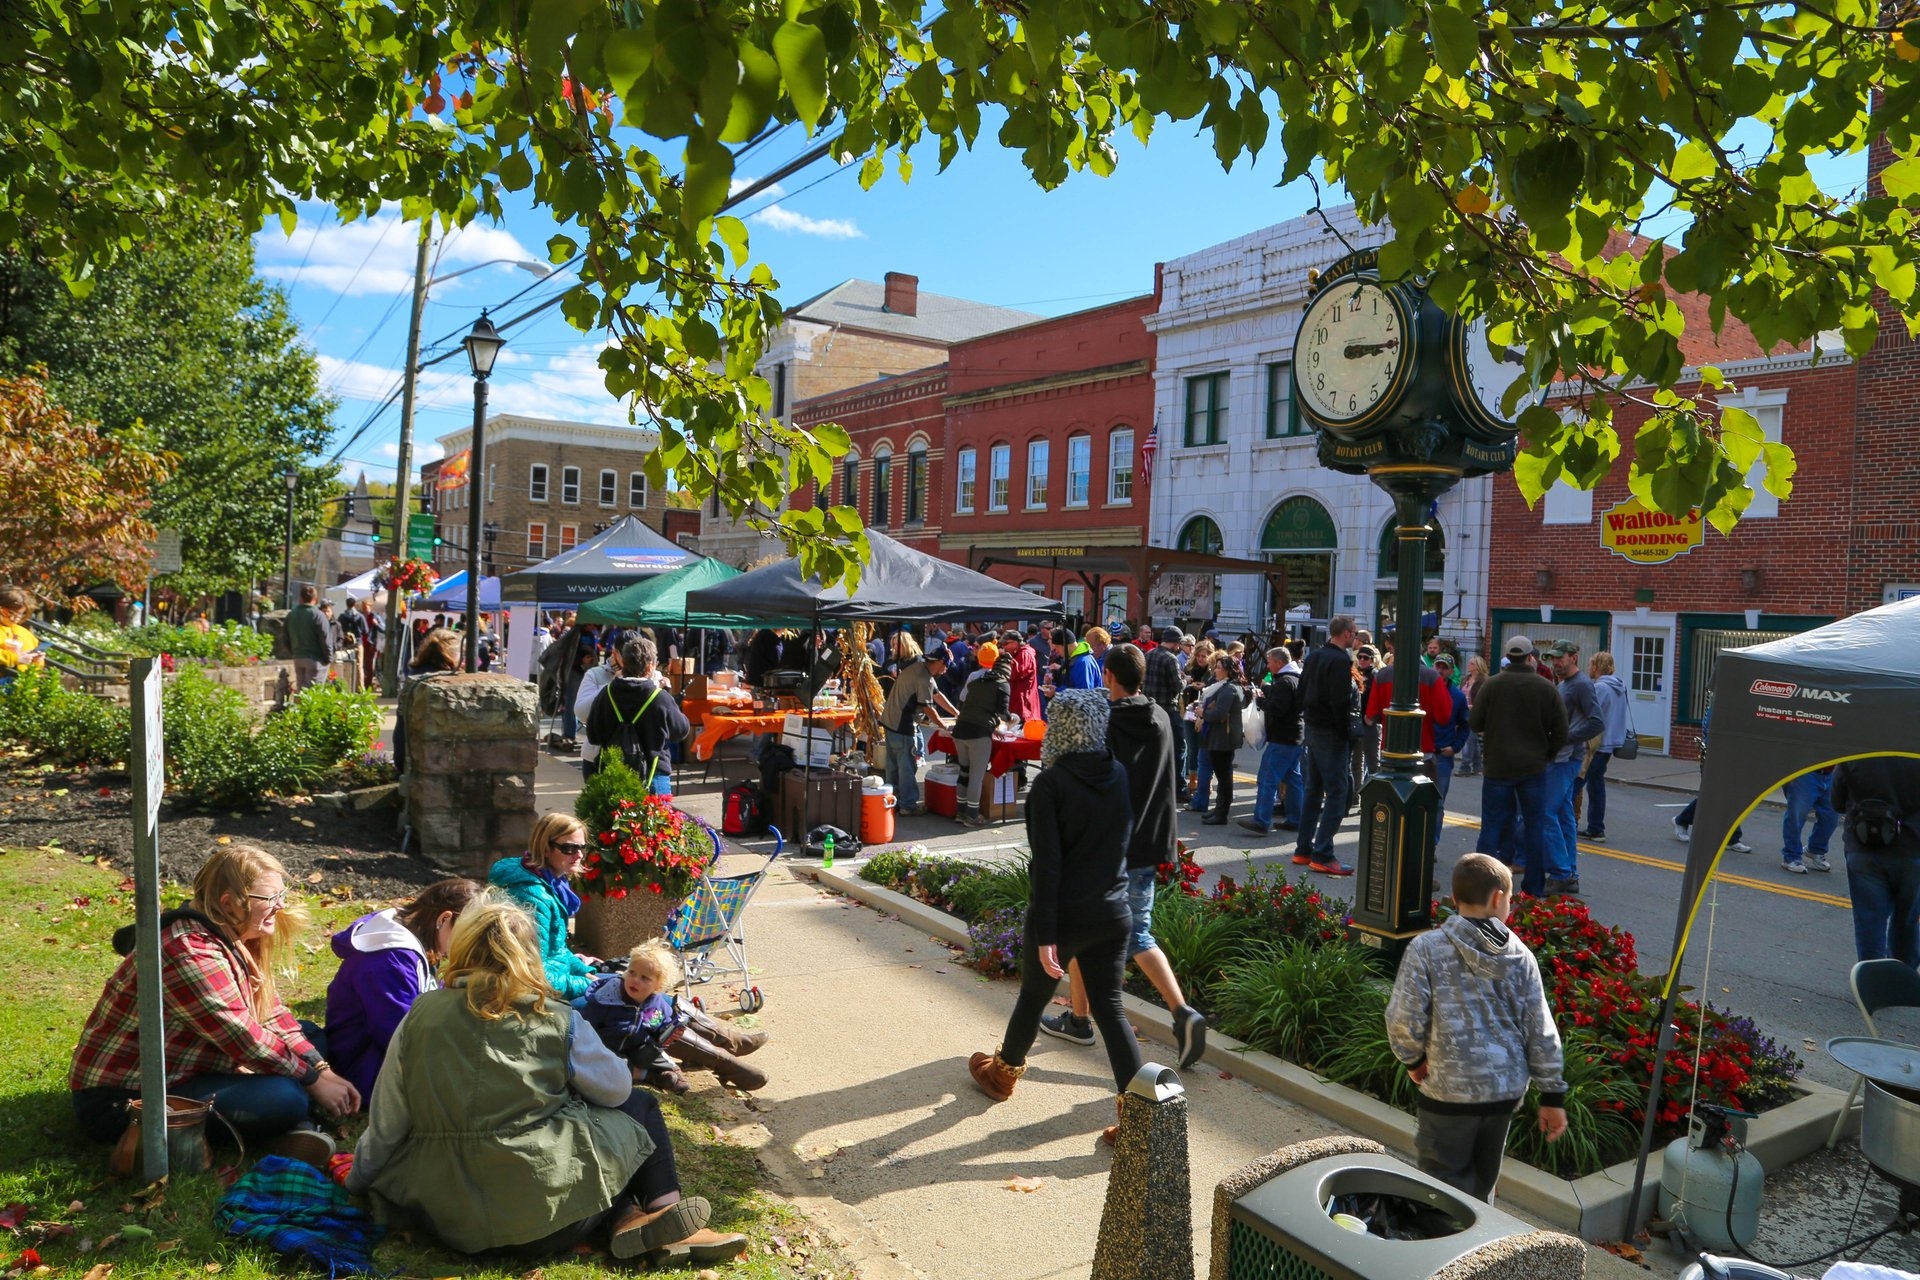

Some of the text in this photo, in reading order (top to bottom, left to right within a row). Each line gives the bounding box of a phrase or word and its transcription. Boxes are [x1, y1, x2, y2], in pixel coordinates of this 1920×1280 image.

[1332, 305, 1342, 323] 11
[1371, 298, 1378, 315] 1
[1211, 316, 1265, 345] BANK
[1386, 313, 1394, 331] 2
[1317, 327, 1328, 346] 10
[1312, 351, 1320, 369] 9
[1384, 361, 1393, 381] 4
[1317, 372, 1325, 391] 8
[1328, 391, 1337, 408] 7
[1369, 383, 1379, 402] 5
[1349, 394, 1357, 412] 6
[1494, 396, 1501, 414] 6
[1336, 441, 1383, 457] ROTARY CLUB
[1465, 446, 1507, 462] ROTARY CLUB
[1607, 509, 1698, 531] Waltos
[1615, 533, 1688, 546] BONDING
[1017, 547, 1084, 557] HAWKS NEST STATE PARK
[1154, 595, 1196, 609] Working
[1174, 608, 1190, 616] You
[1754, 681, 1787, 693] Coleman
[1758, 705, 1832, 722] Instant Canopy
